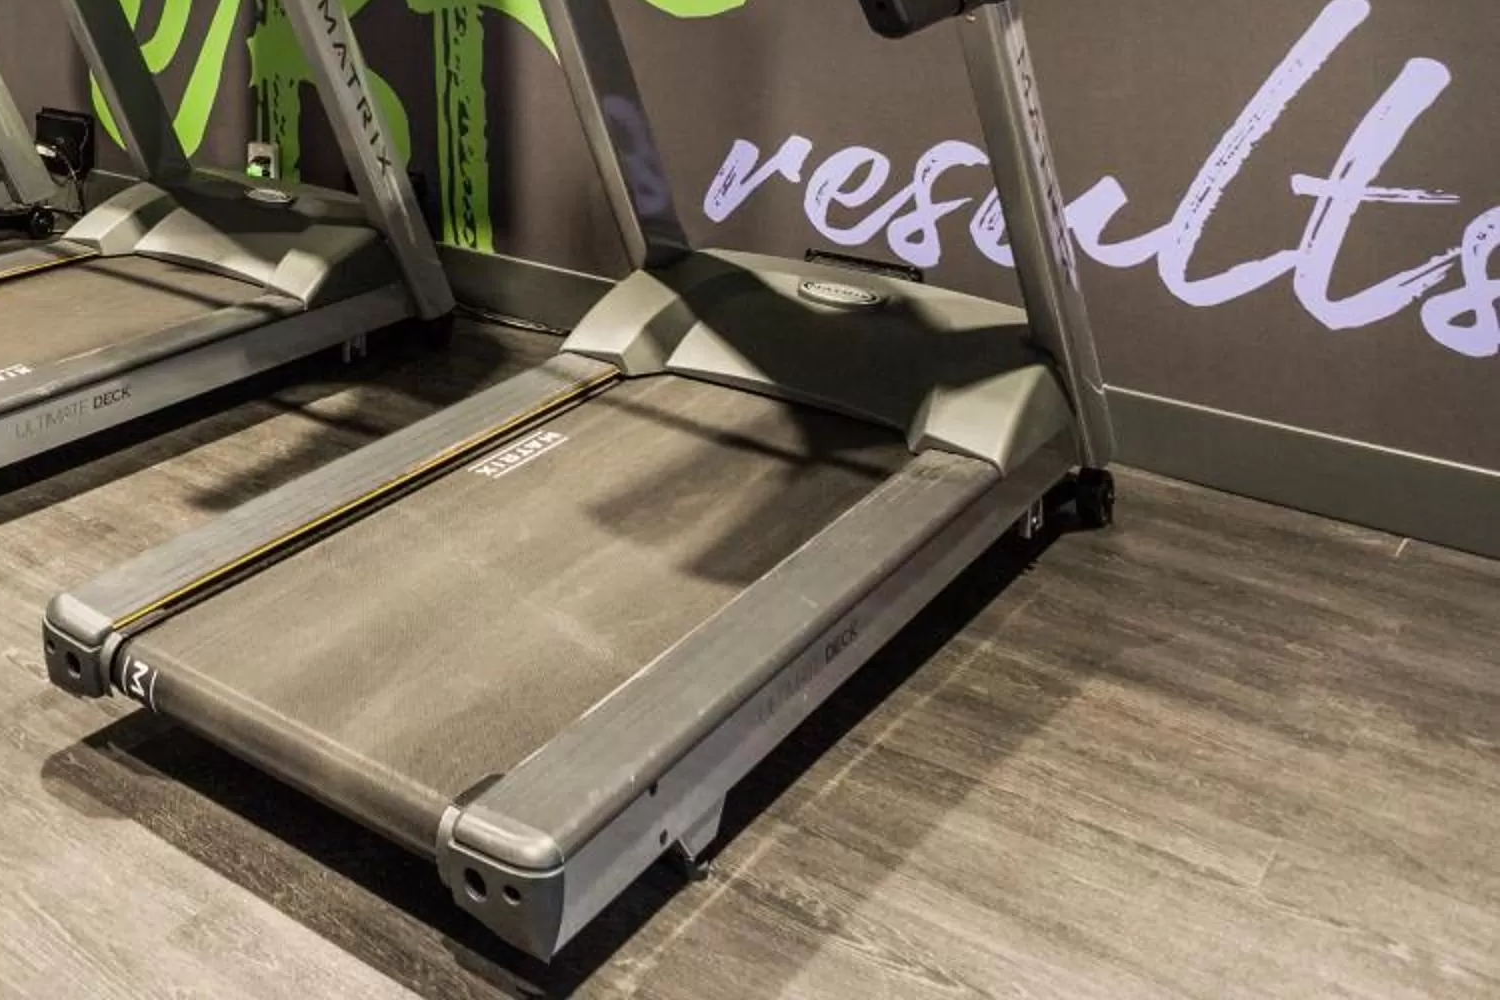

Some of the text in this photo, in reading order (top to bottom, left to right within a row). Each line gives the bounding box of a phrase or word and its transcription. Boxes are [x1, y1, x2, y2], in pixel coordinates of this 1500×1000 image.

[13, 382, 133, 439] ULTIMATE DECK
[473, 430, 563, 477] MATRIX
